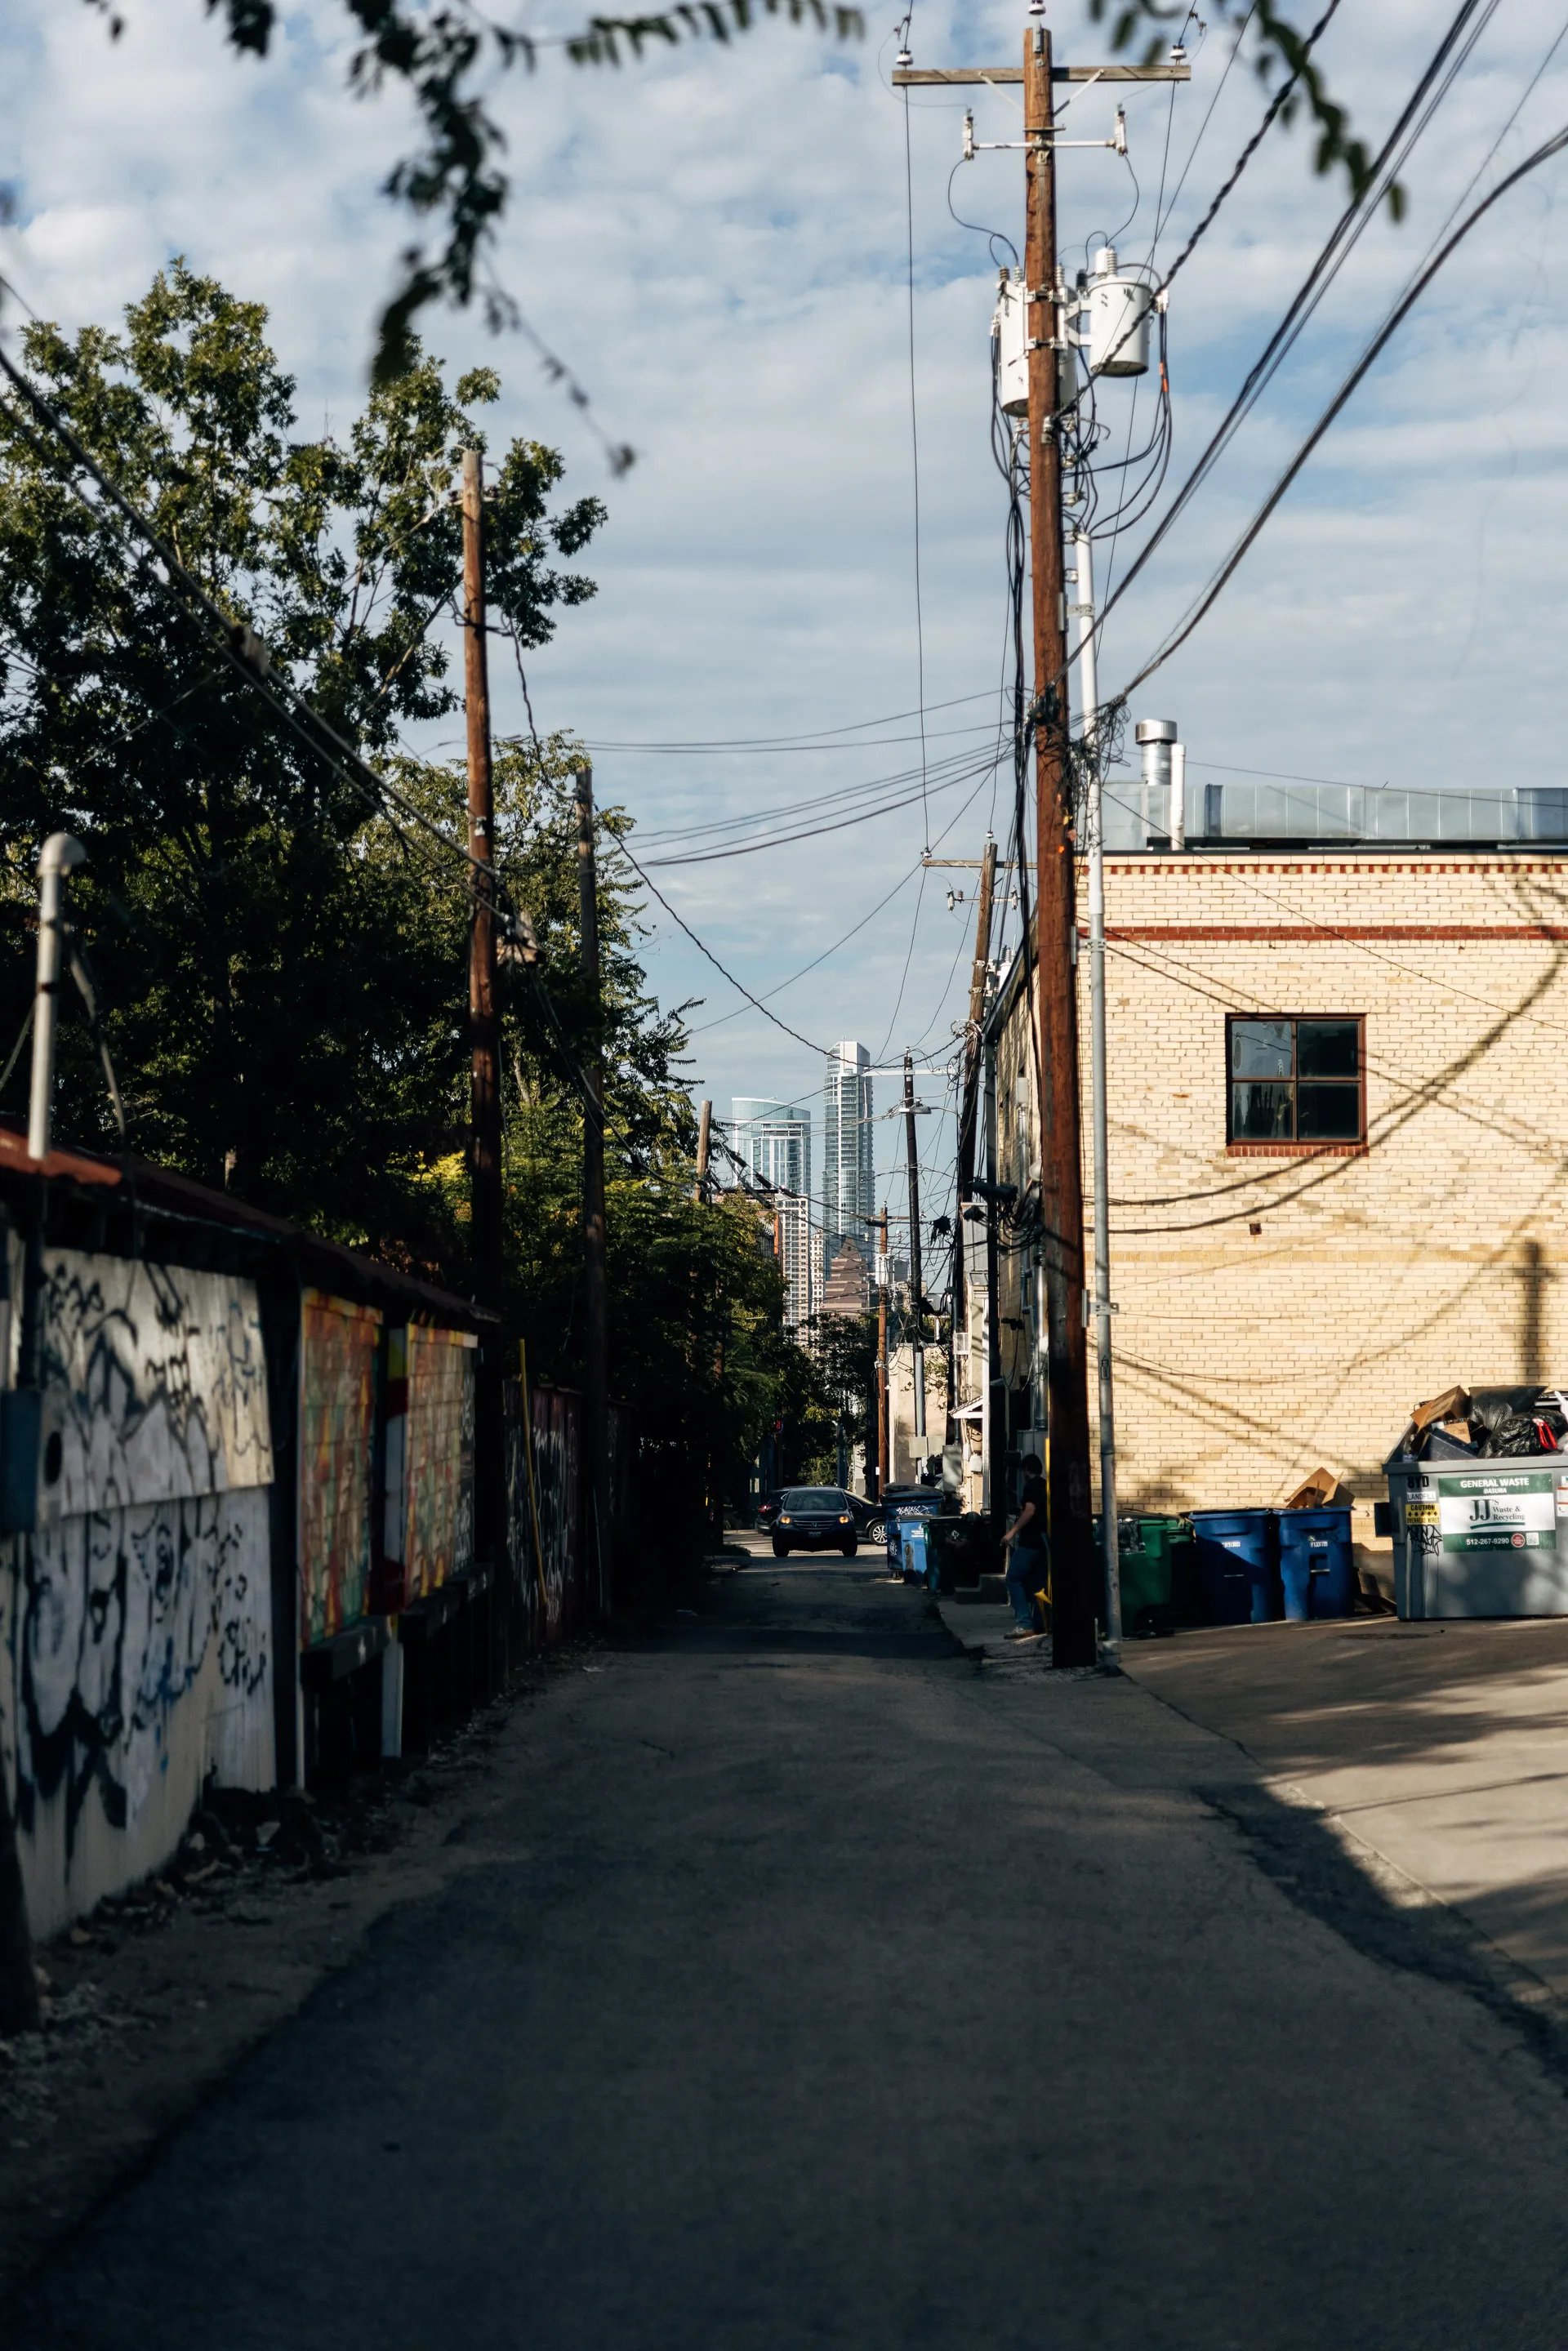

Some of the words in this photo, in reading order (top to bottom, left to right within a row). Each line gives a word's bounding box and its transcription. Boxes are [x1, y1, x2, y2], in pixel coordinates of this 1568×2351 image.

[1407, 1475, 1429, 1488] 8YD
[1460, 1479, 1499, 1488] GENERAL
[1499, 1478, 1530, 1486] WASTE
[1407, 1493, 1436, 1501] LANDFILL
[1493, 1513, 1526, 1521] Recycling
